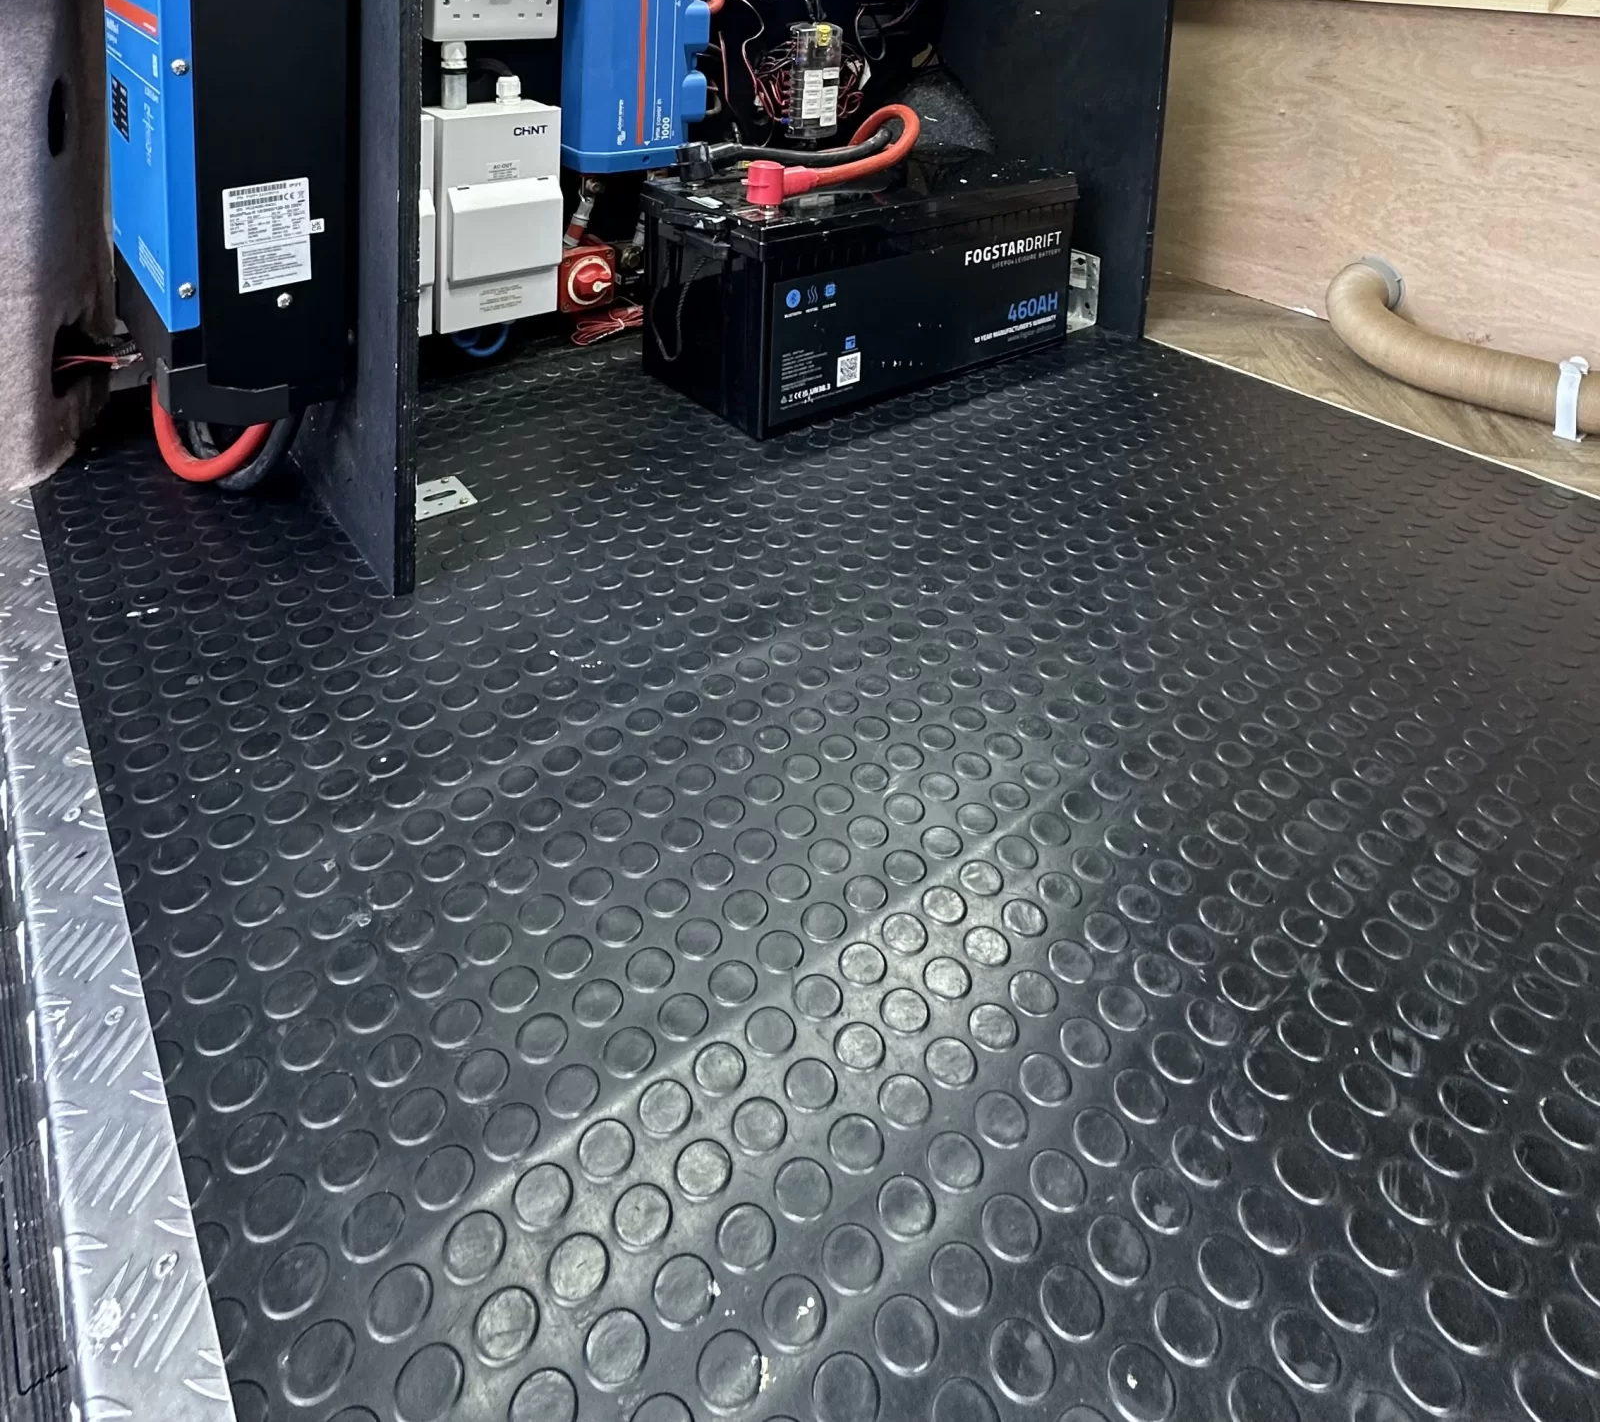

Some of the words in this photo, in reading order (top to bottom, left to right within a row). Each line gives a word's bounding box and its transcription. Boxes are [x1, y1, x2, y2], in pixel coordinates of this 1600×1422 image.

[661, 116, 670, 140] 1000
[1014, 253, 1037, 265] LEISURE
[1038, 248, 1061, 258] BATTERY
[1007, 291, 1059, 322] 460AH
